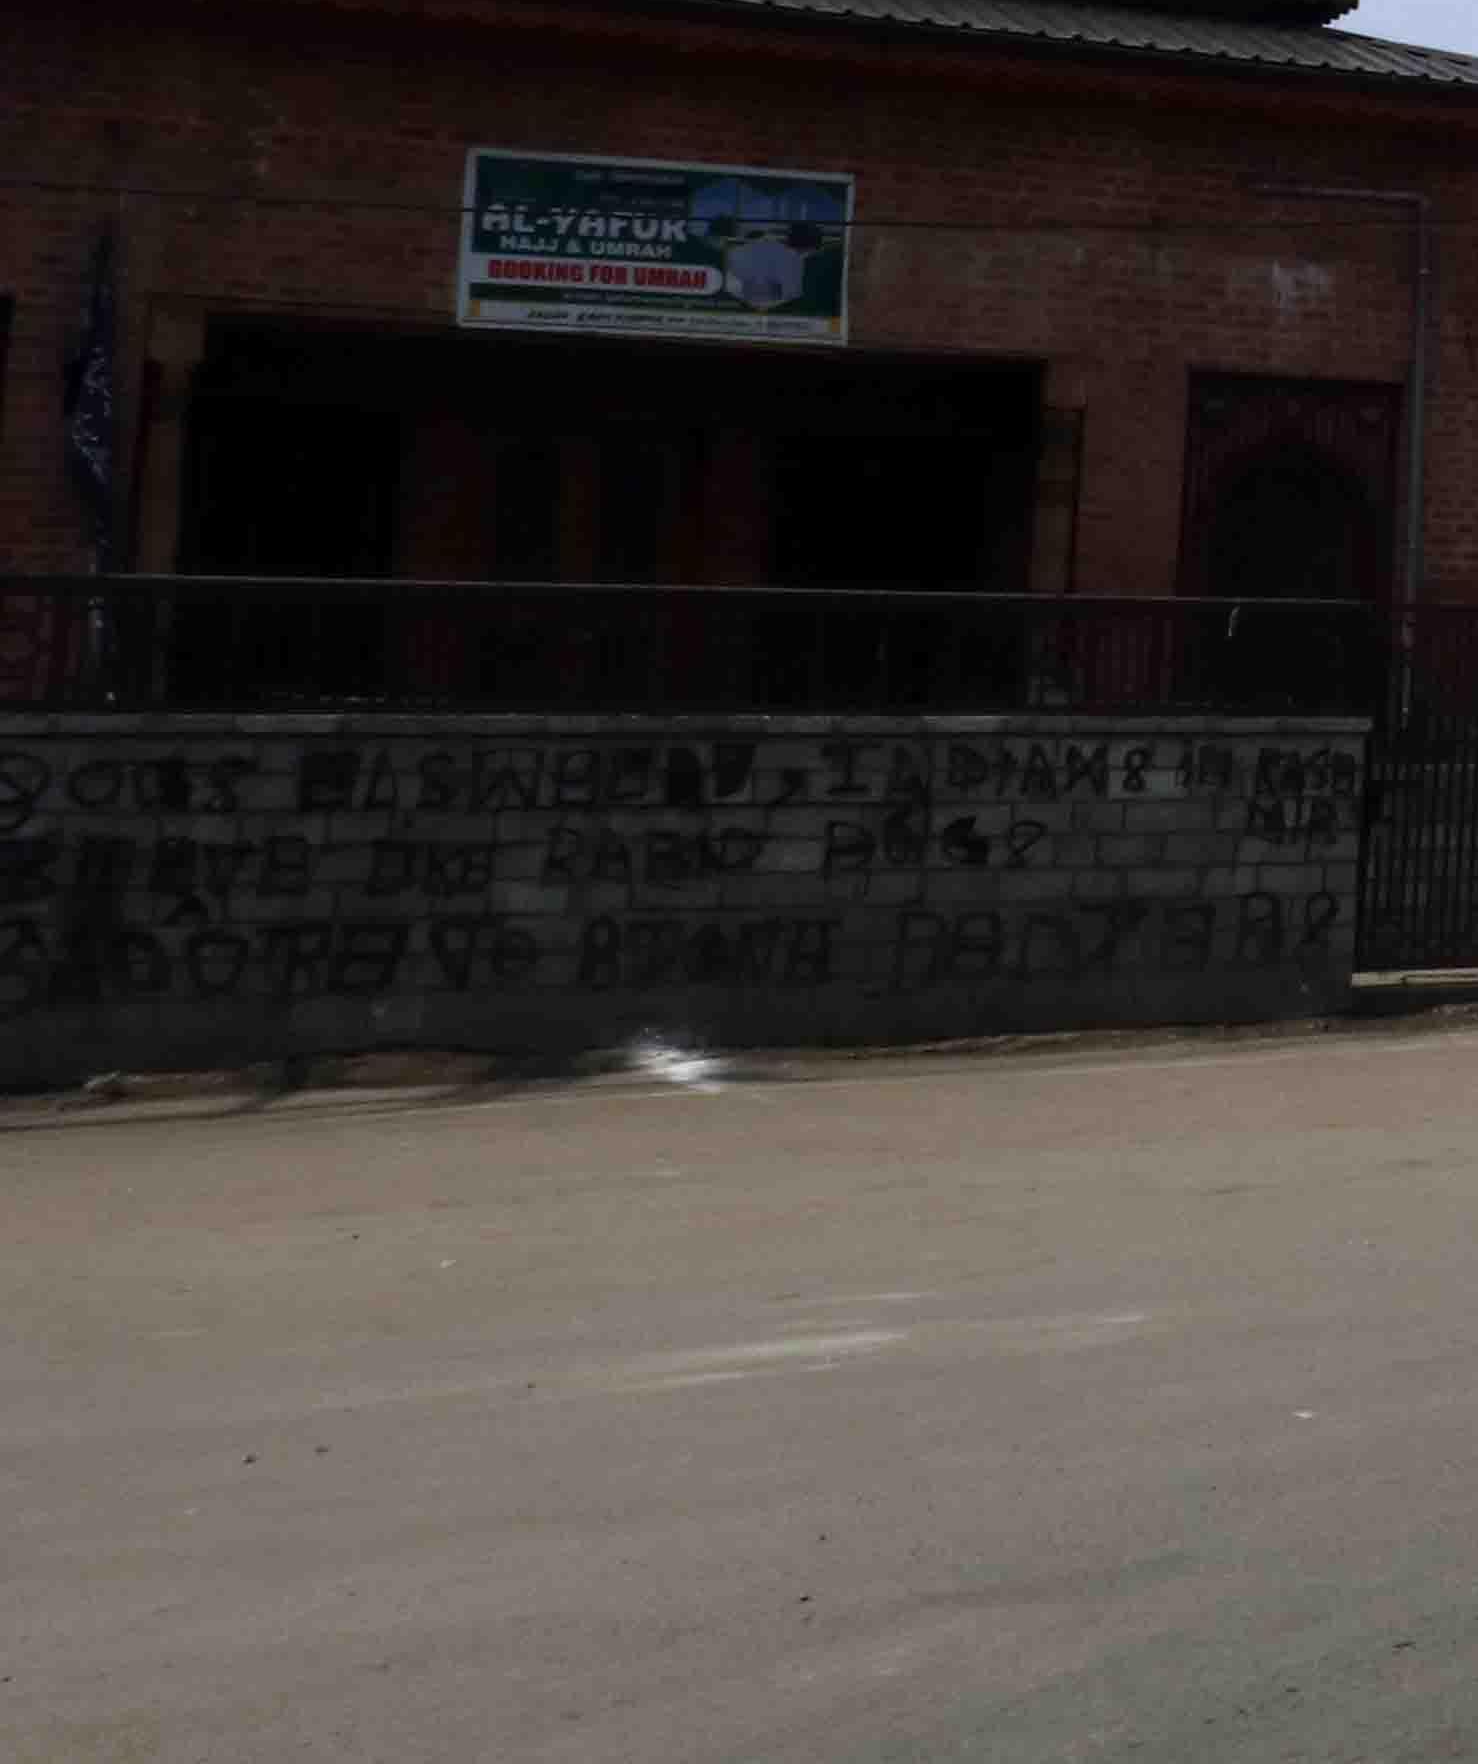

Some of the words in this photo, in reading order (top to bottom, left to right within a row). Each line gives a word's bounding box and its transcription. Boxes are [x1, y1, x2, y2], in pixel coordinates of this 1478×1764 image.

[591, 240, 674, 261] UMRAH
[487, 259, 584, 283] BOOKING
[590, 264, 628, 286] FOR
[634, 266, 708, 290] UMRAH
